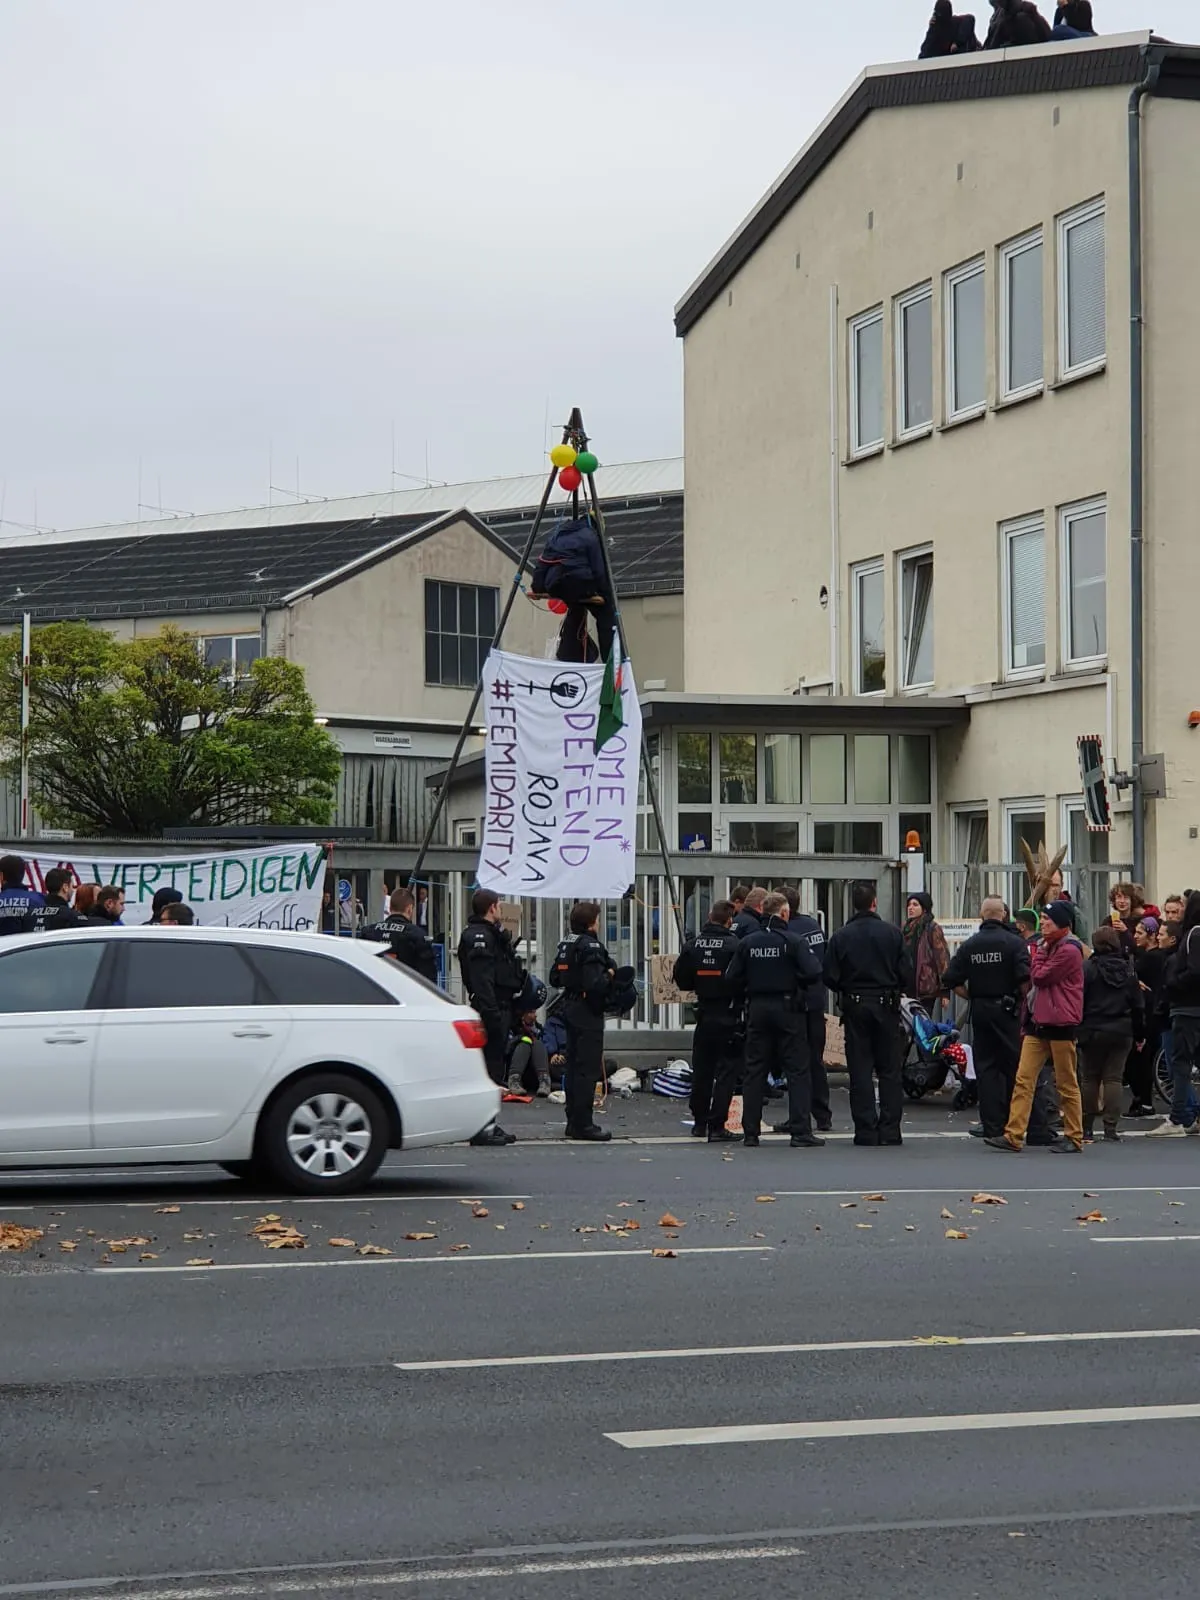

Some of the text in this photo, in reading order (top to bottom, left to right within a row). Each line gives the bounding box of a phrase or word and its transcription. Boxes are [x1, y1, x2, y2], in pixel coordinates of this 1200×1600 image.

[484, 678, 517, 877] #FEMIDARITY
[594, 688, 632, 853] OMEN
[559, 713, 596, 867] DEFEND
[521, 771, 559, 882] ROJAVA
[91, 847, 325, 904] VERTEIDIGEN
[0, 897, 30, 908] OLIZEI
[374, 922, 405, 933] POLIZEI
[694, 938, 724, 948] POLIZEI
[750, 947, 780, 958] POLIZEI
[970, 951, 1003, 965] POLIZEI
